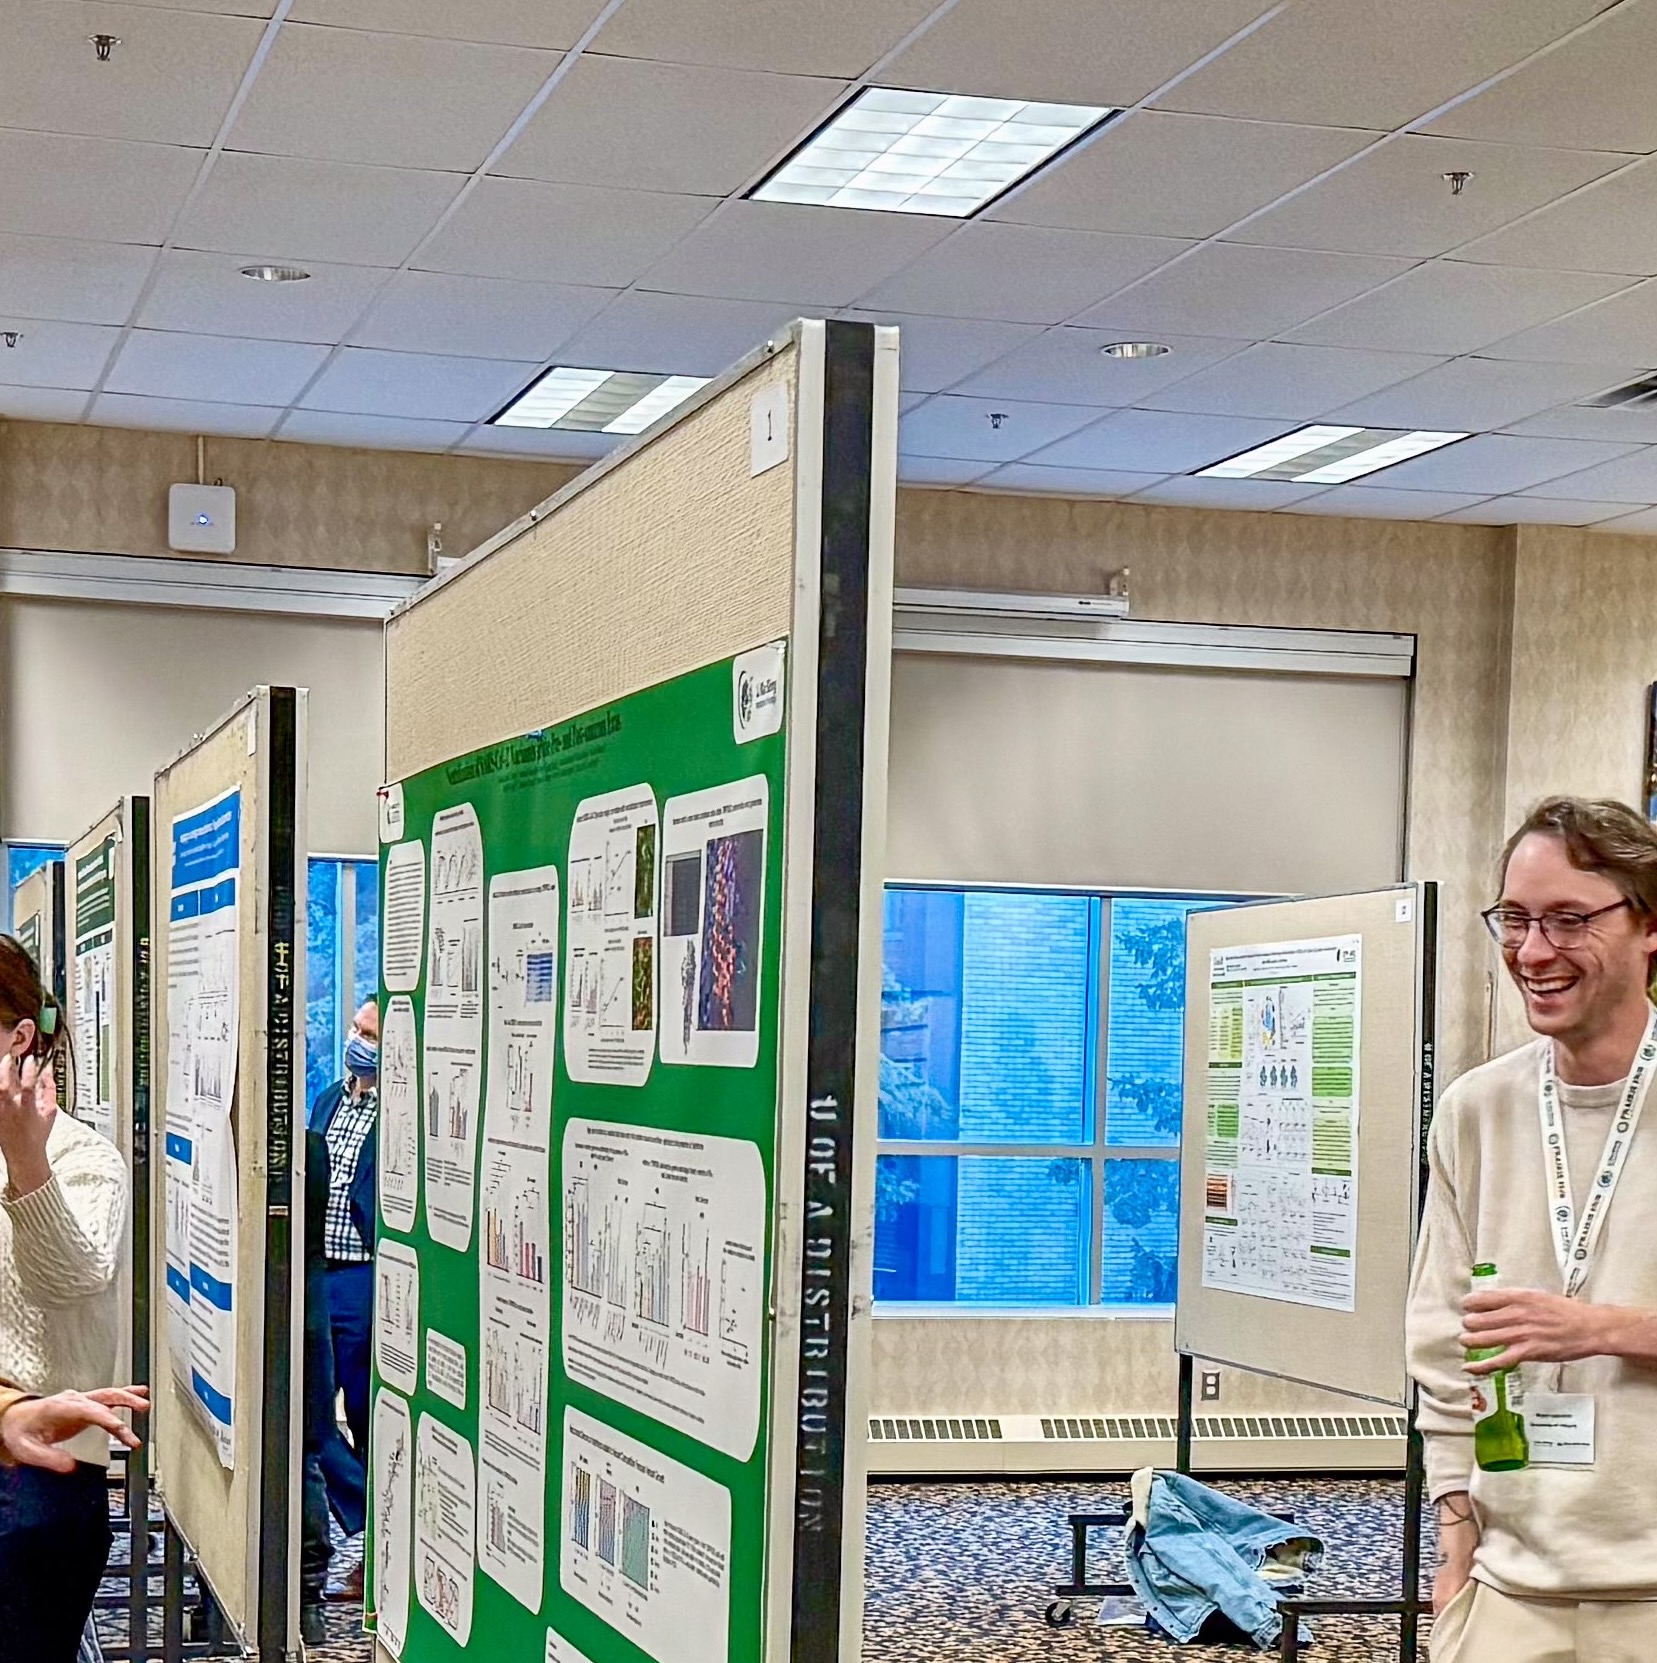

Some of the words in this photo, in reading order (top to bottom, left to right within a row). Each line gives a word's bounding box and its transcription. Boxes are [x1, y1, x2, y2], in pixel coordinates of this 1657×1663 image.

[767, 409, 773, 442] 1
[808, 1137, 837, 1185] OF
[807, 1200, 834, 1219] A
[799, 1237, 833, 1533] DISTRIBUTION
